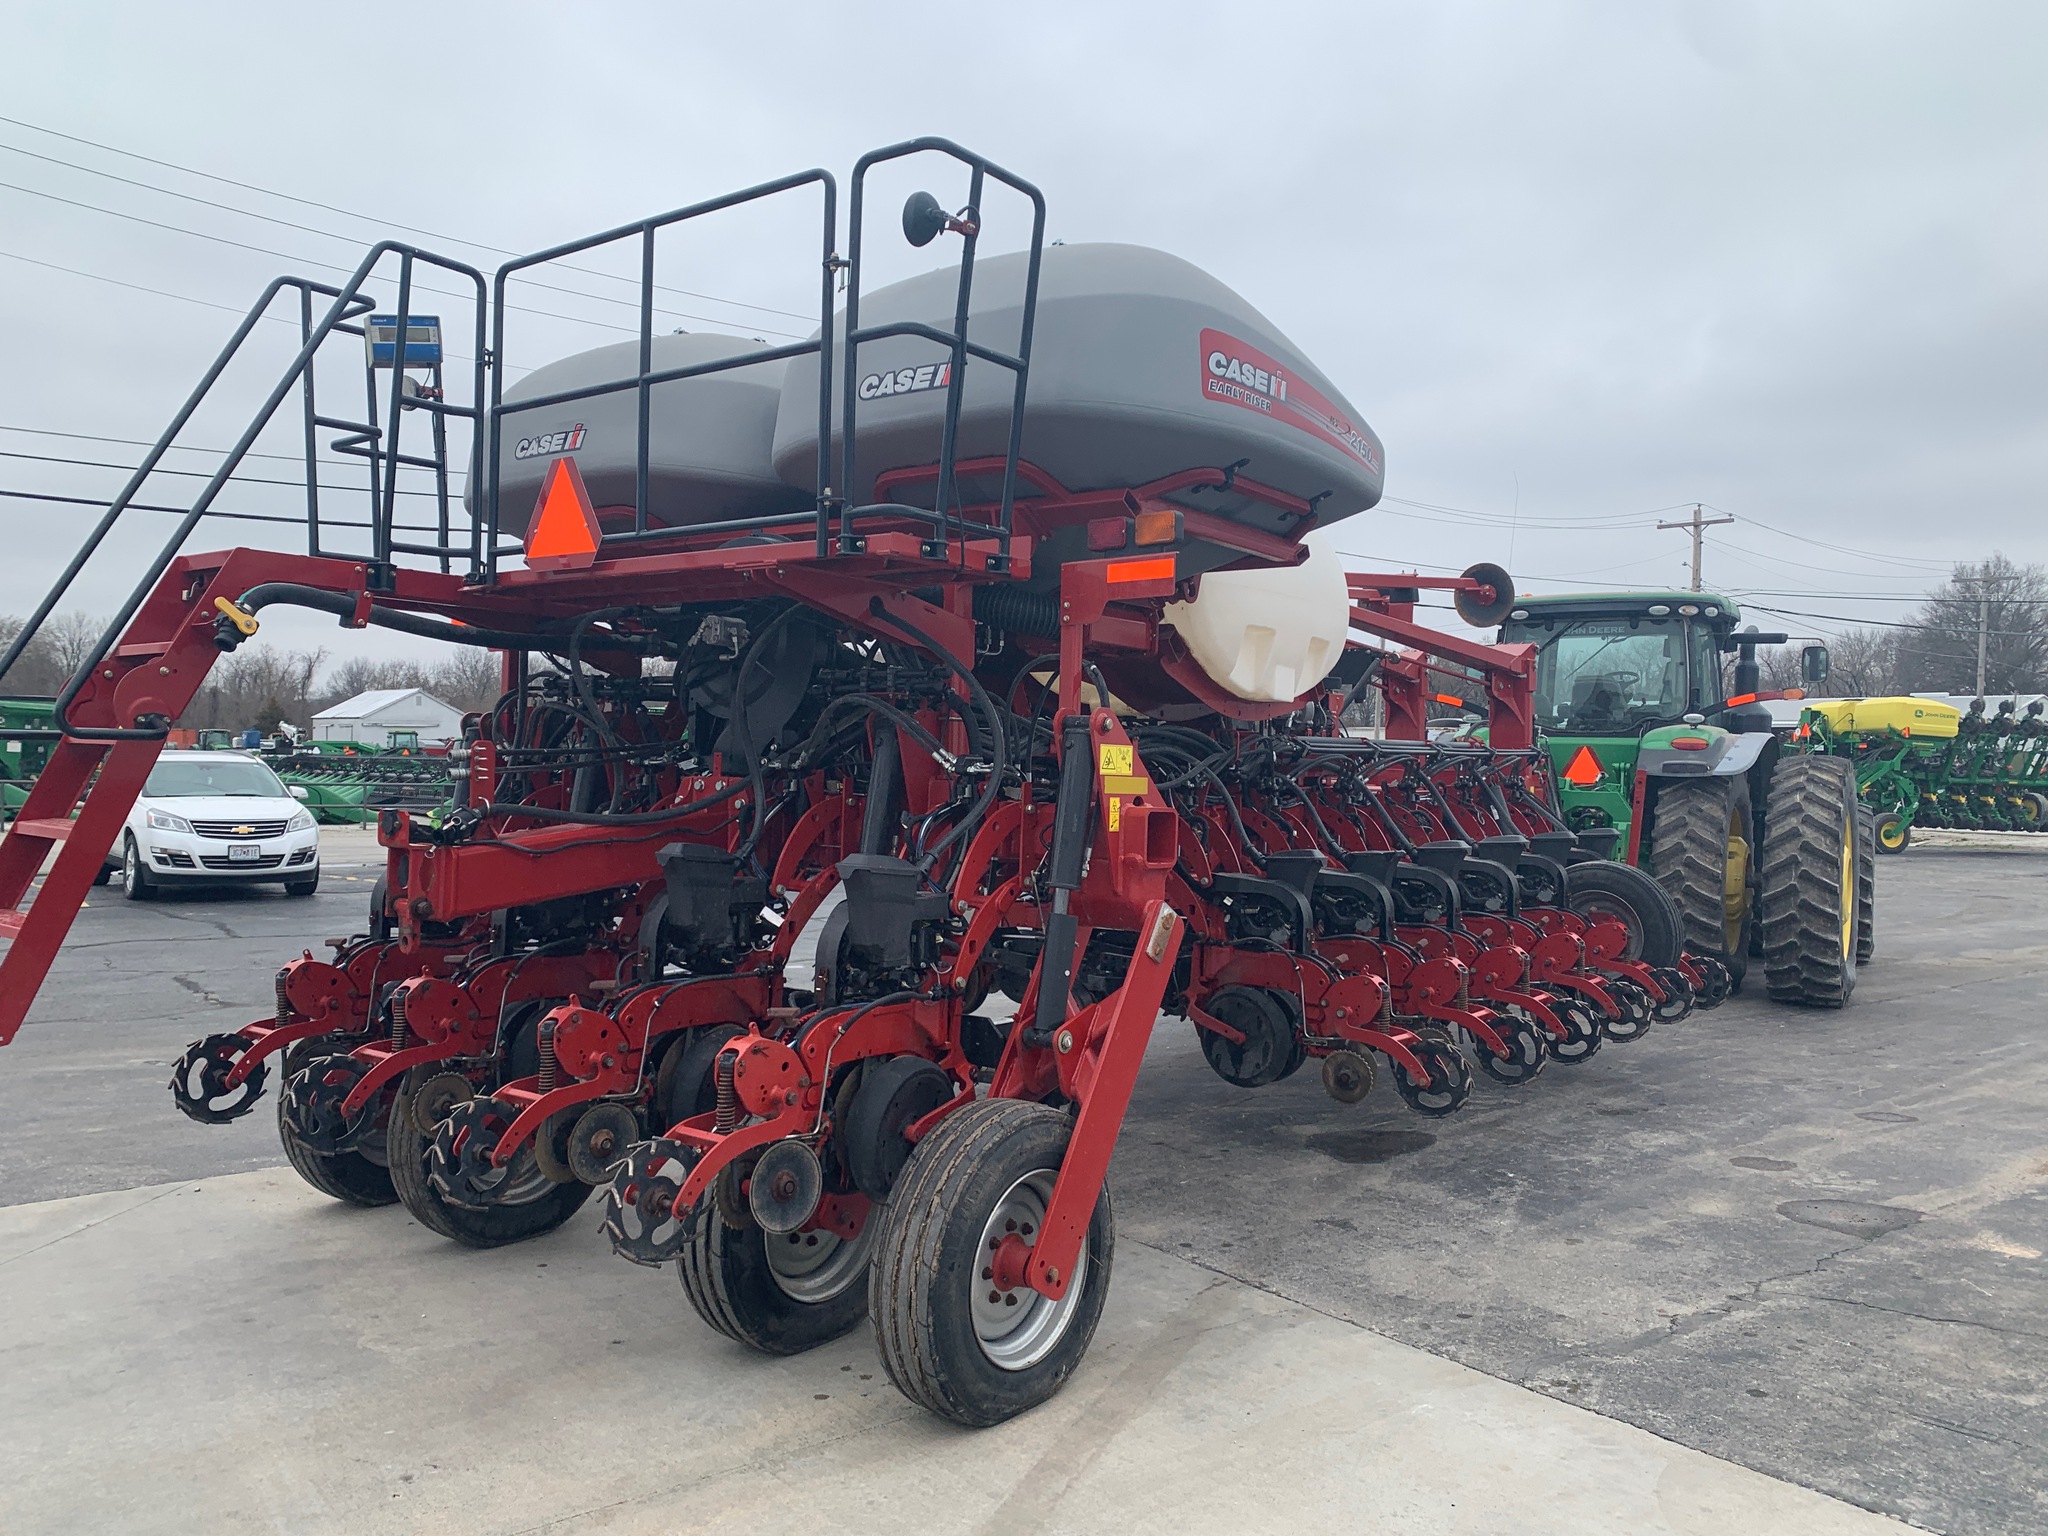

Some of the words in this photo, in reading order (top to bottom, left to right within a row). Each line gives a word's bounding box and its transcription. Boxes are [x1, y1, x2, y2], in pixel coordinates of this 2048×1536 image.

[859, 363, 936, 400] CASE
[1208, 351, 1268, 394] CASE
[1208, 379, 1244, 400] EARLY
[1244, 391, 1272, 413] RISER
[515, 433, 566, 460] CASE
[1350, 430, 1373, 463] 2150
